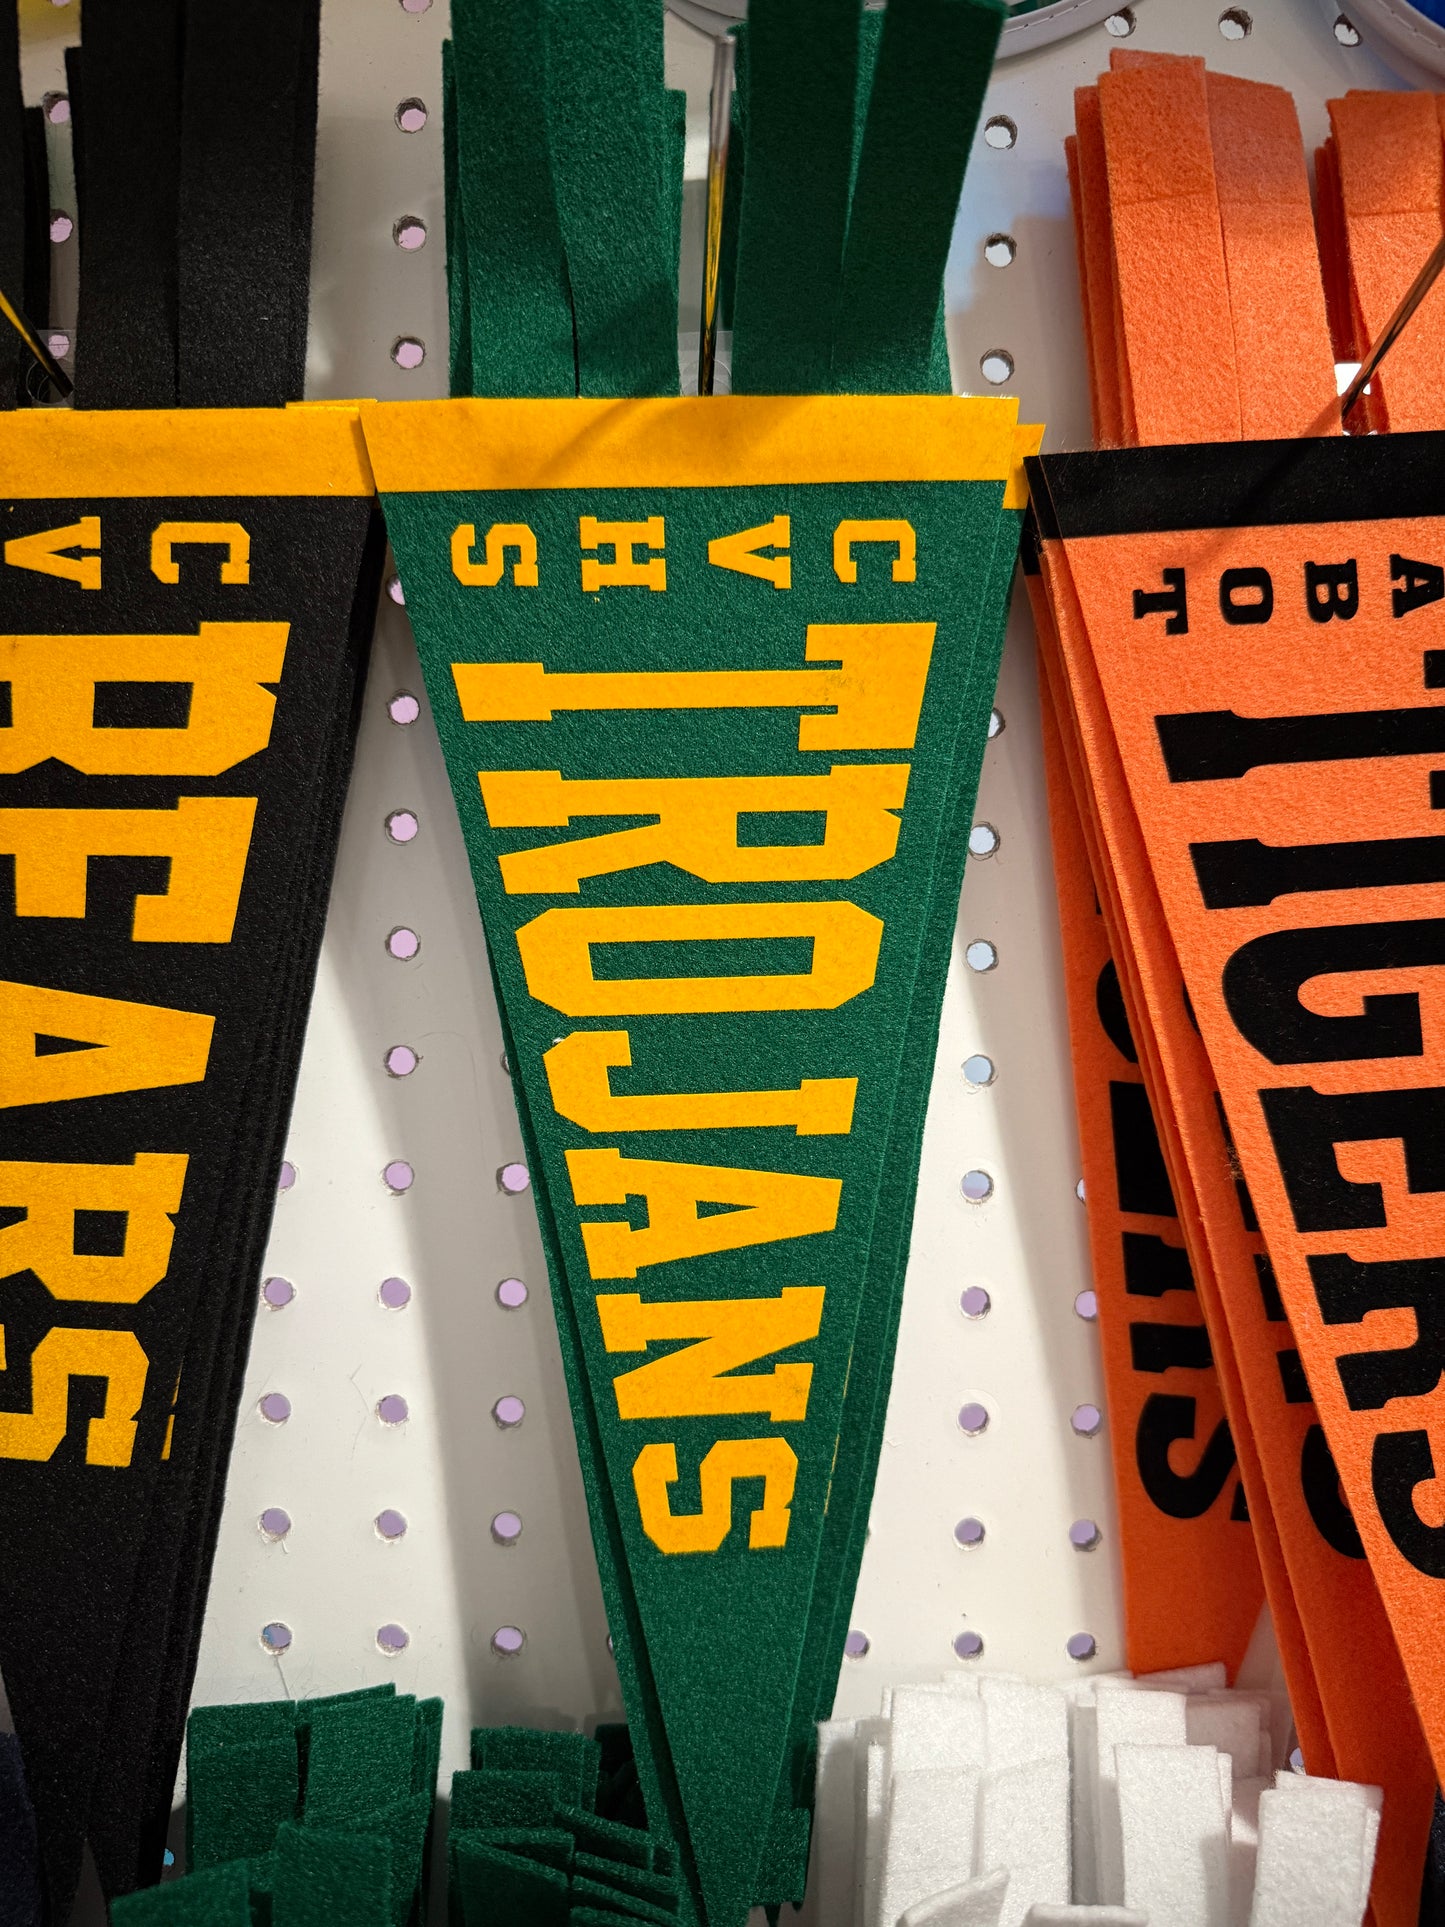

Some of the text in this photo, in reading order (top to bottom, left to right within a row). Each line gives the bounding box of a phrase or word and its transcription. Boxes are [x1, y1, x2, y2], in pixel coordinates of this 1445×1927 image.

[4, 516, 251, 590] CV
[450, 515, 917, 591] CVHS
[1132, 553, 1445, 636] ABOT
[0, 621, 291, 1467] BEARS
[450, 622, 938, 1556] TROJANS
